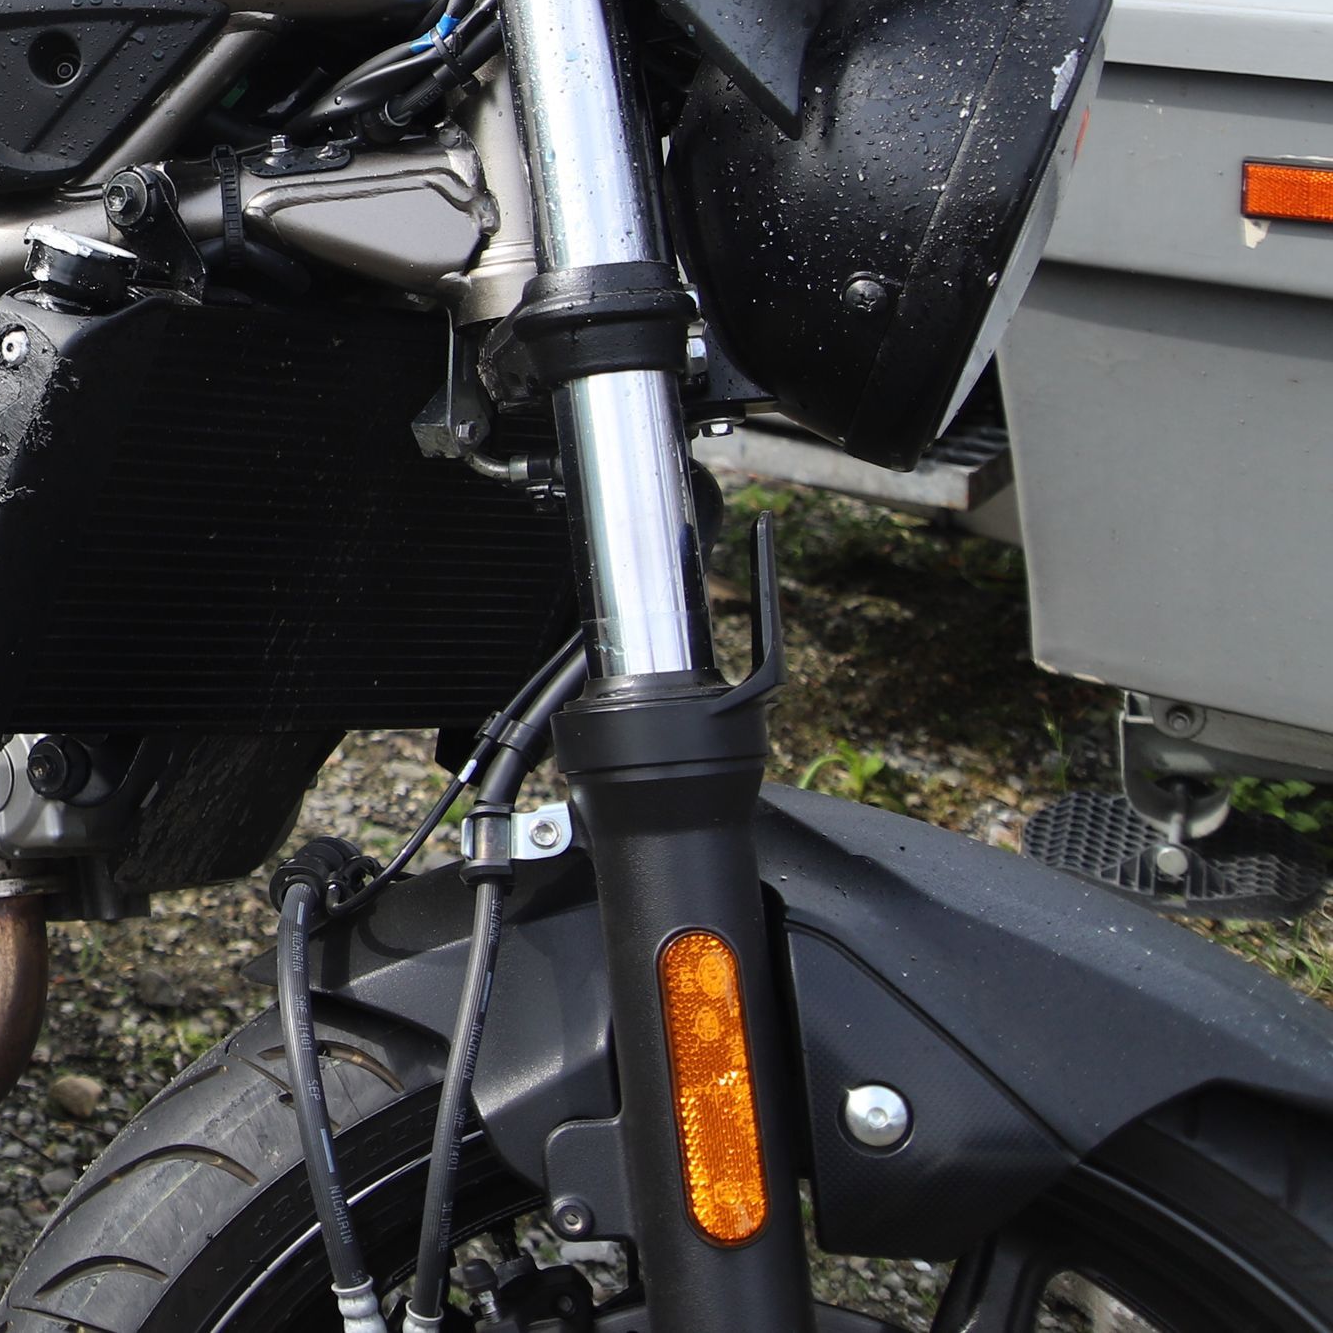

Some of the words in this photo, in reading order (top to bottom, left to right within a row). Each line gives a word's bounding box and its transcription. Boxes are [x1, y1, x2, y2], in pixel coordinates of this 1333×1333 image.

[291, 930, 305, 973] NICHIRIN
[298, 1019, 313, 1052] J1401
[307, 1079, 321, 1102] SEP
[328, 1184, 354, 1246] NICHIRIN
